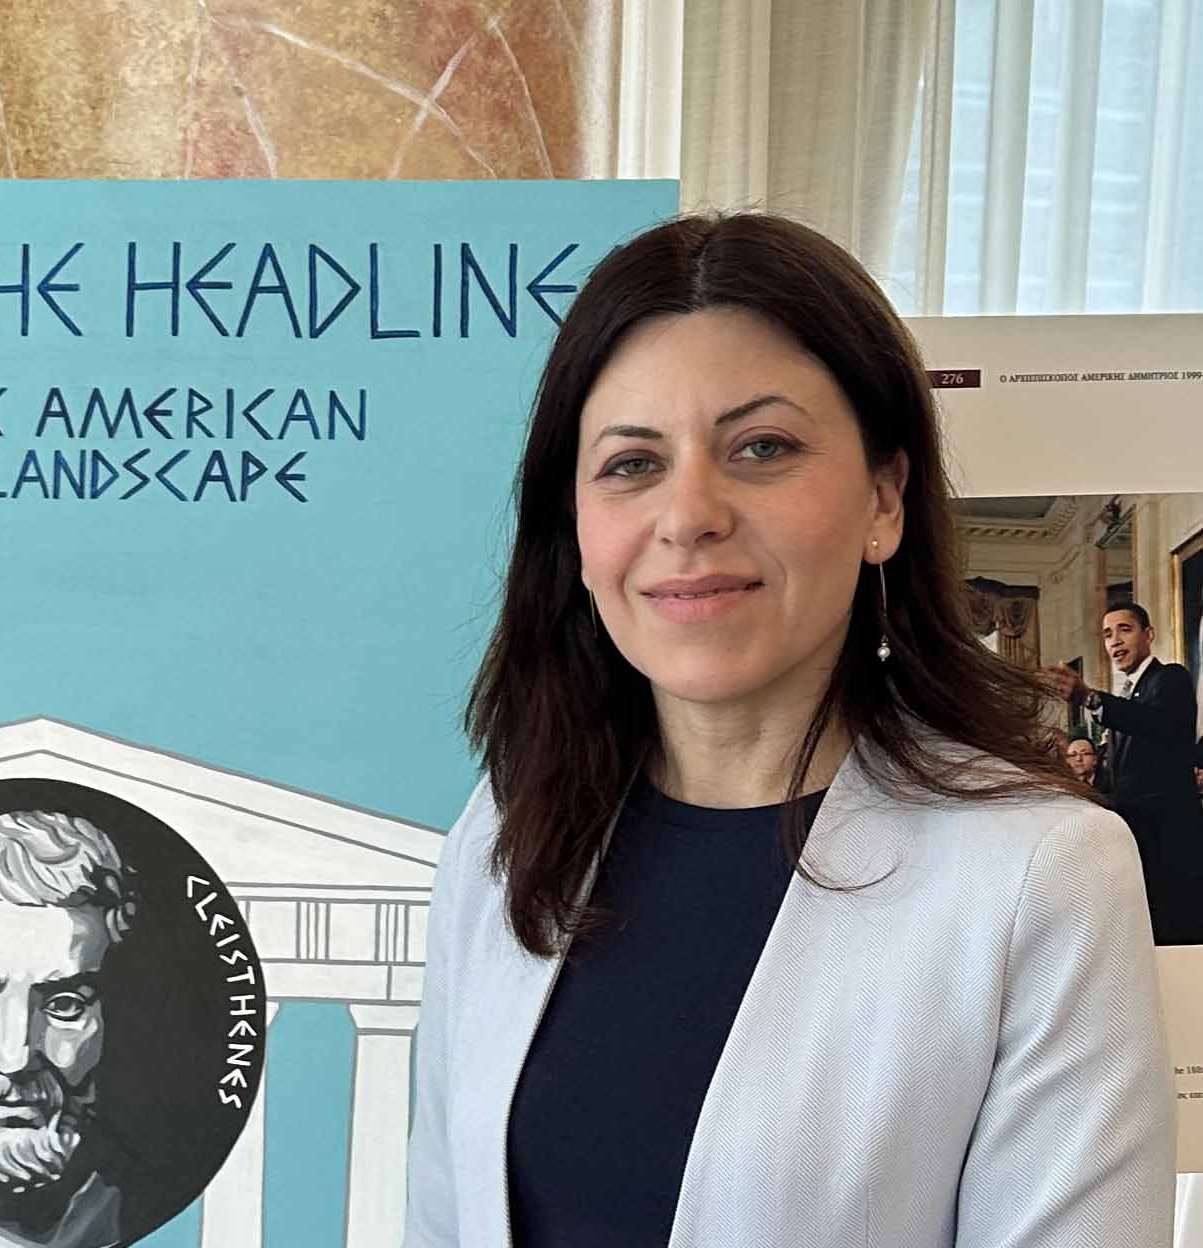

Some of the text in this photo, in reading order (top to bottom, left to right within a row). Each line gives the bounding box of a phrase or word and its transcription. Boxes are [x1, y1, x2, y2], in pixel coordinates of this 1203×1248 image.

[125, 241, 623, 340] HEADLINE
[36, 387, 367, 441] AMERICAN
[941, 373, 965, 385] 276
[187, 875, 257, 1108] CLEISTHENES
